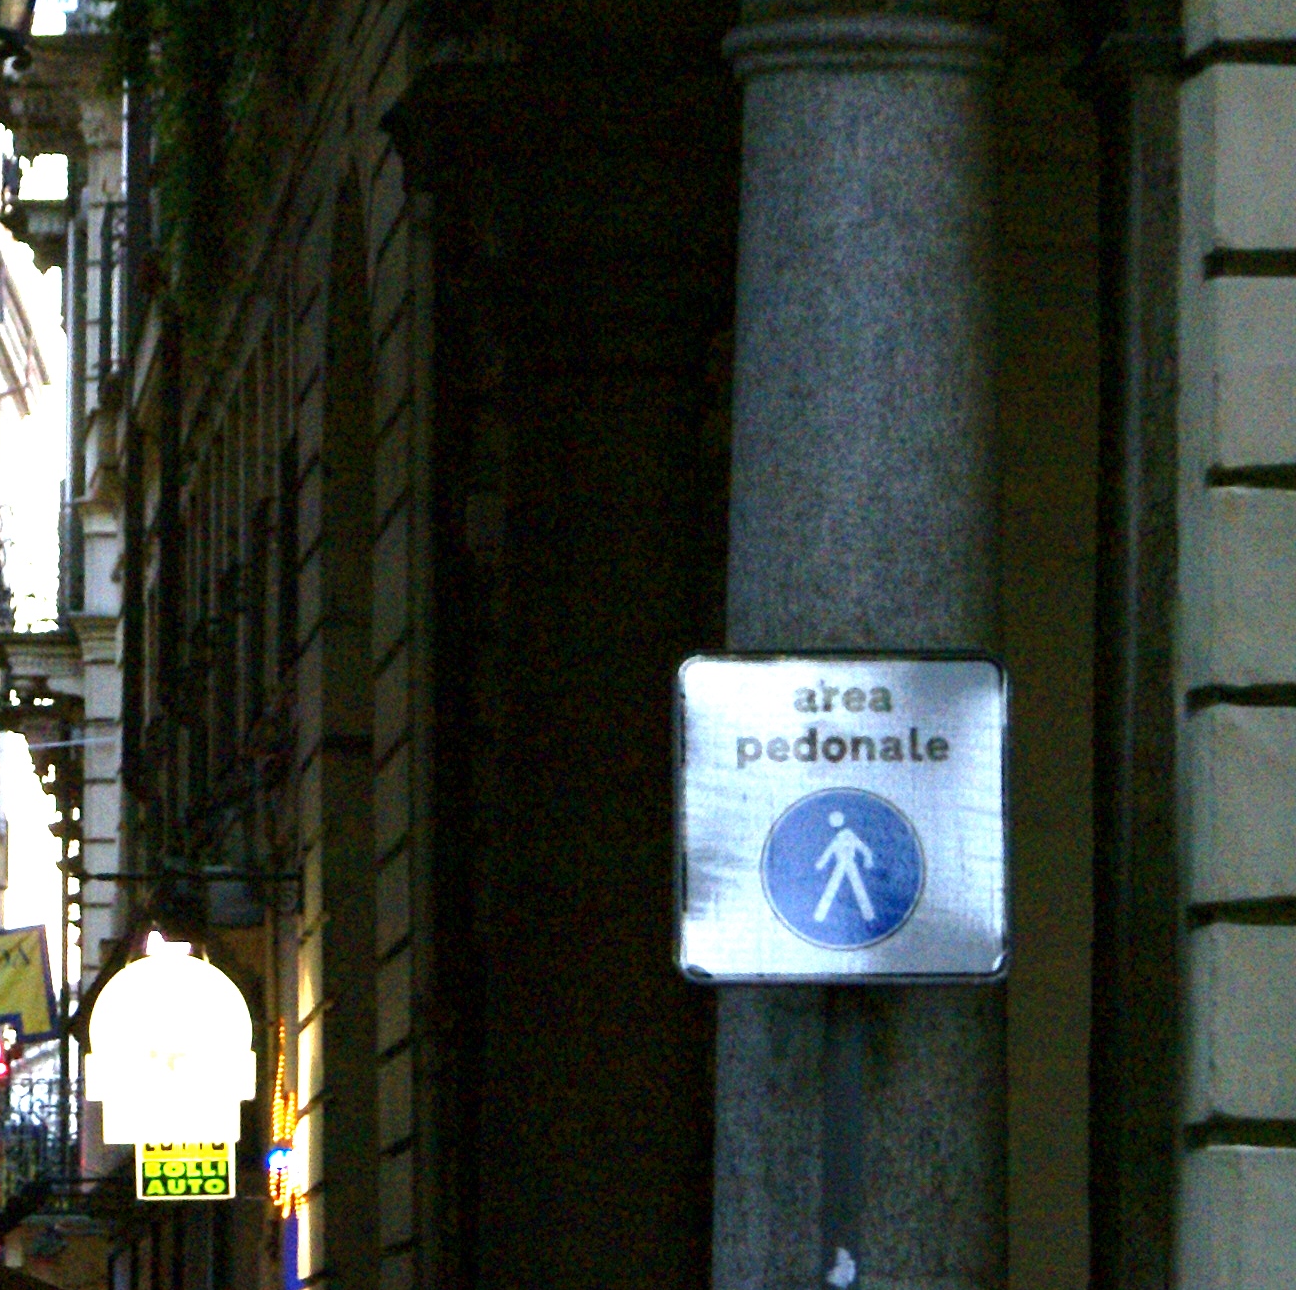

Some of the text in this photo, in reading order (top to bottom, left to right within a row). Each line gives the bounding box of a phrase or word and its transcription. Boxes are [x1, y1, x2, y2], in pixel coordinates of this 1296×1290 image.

[793, 685, 894, 713] area
[736, 726, 951, 769] pedonale
[144, 1160, 227, 1177] BOLLI
[146, 1178, 226, 1195] AUTO
